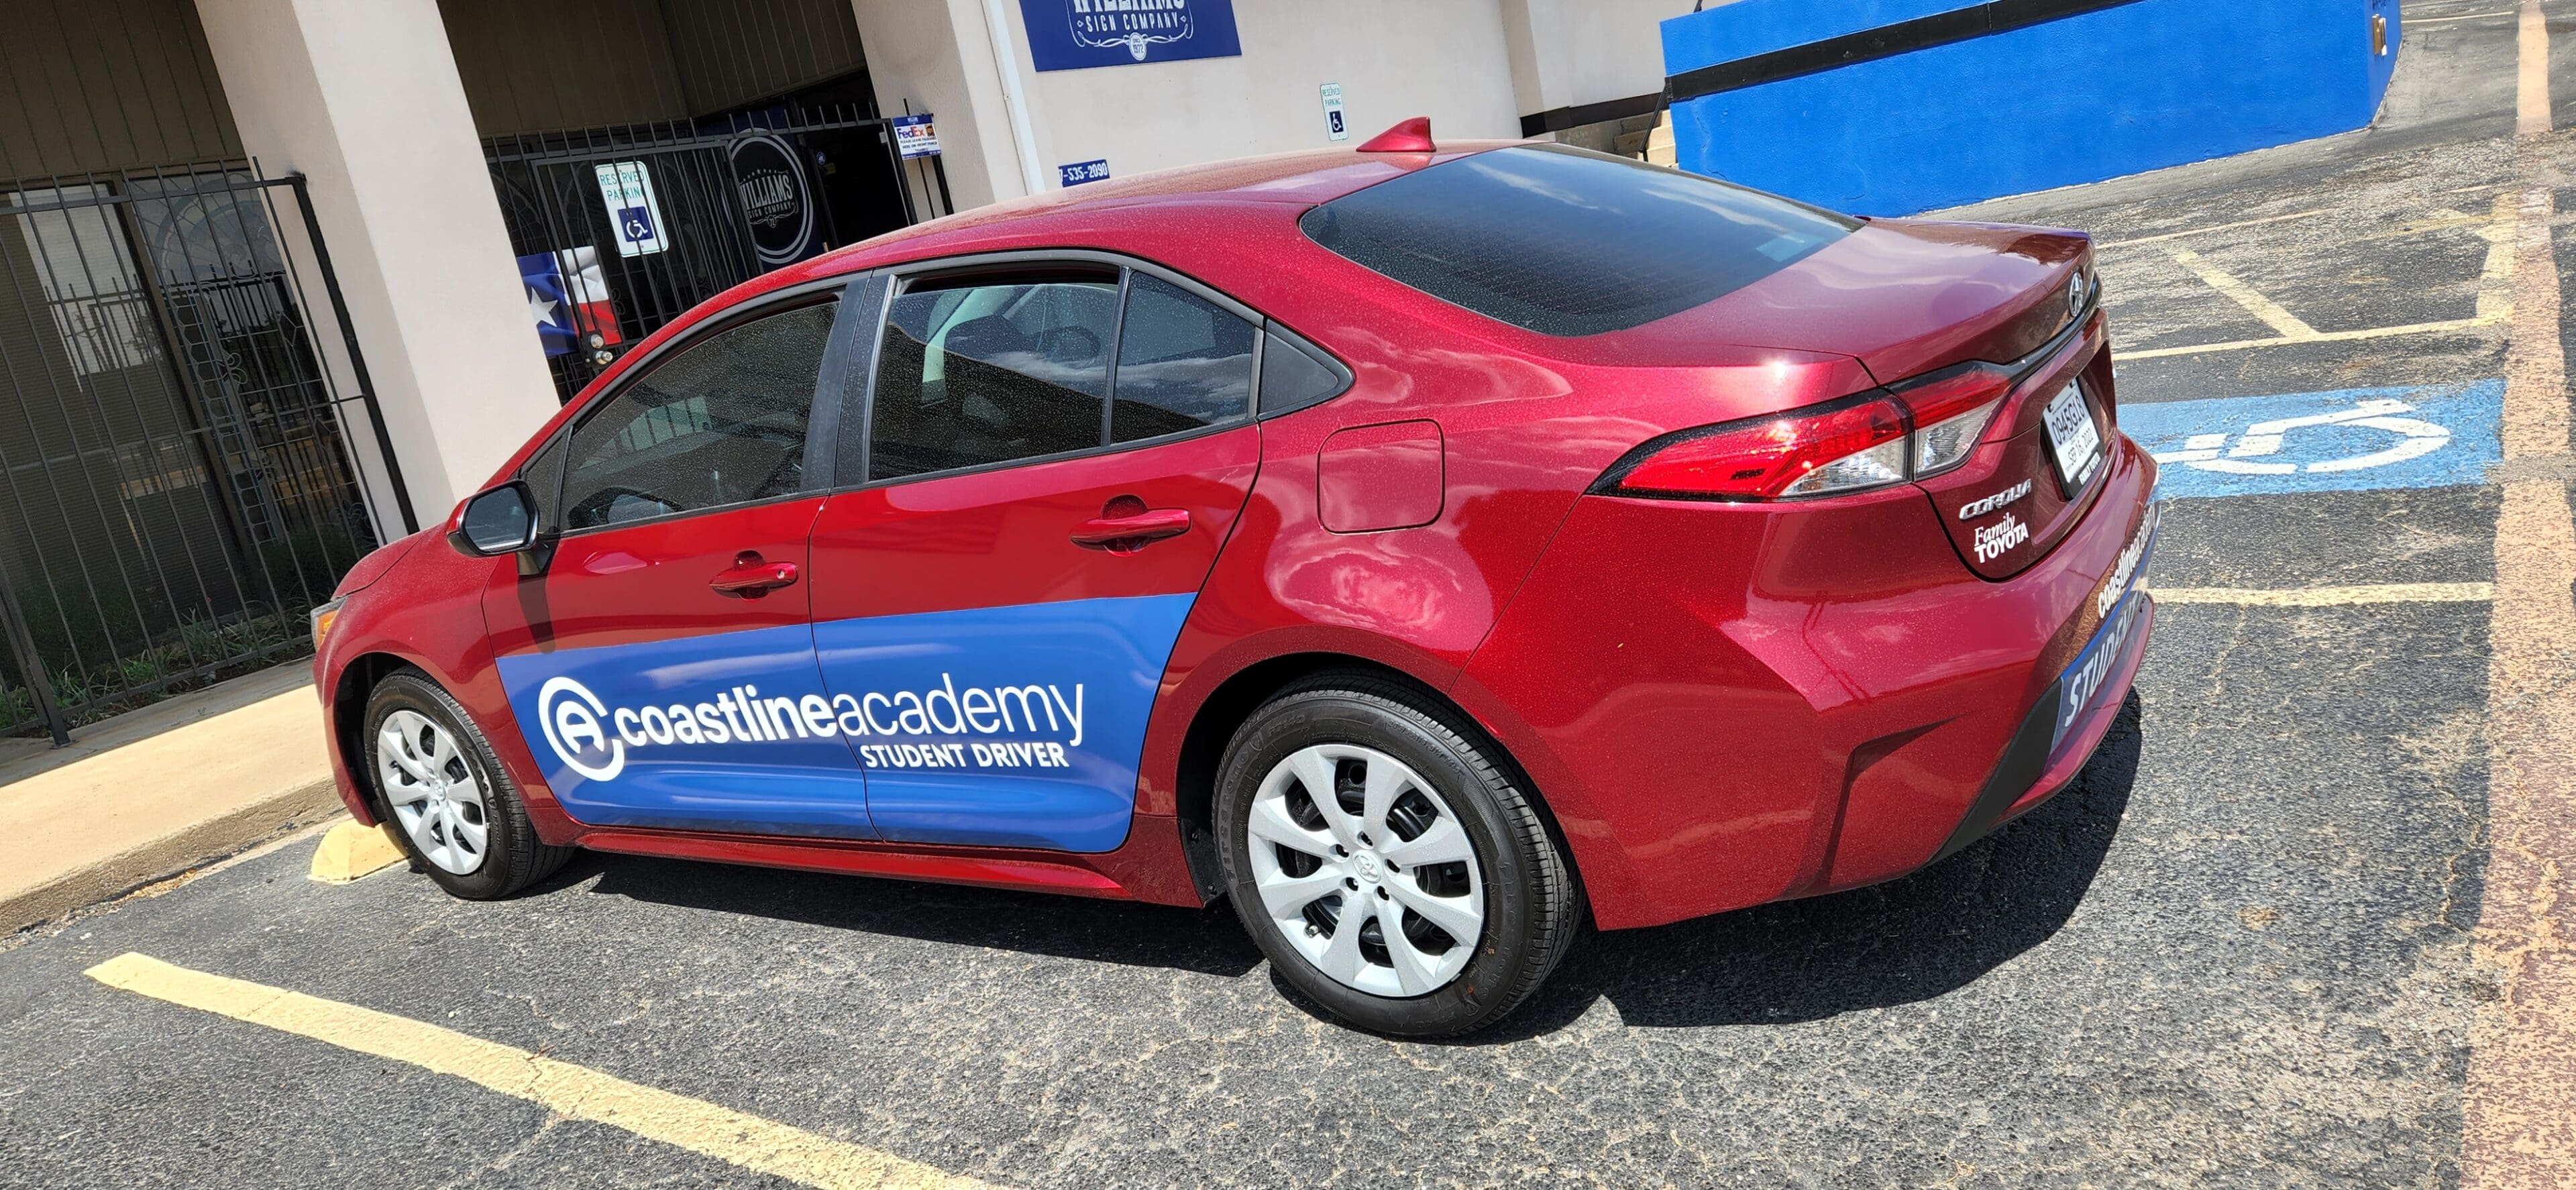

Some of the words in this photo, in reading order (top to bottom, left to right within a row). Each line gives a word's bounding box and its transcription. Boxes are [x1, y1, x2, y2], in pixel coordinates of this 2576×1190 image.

[1085, 15, 1116, 32] SIGN
[1123, 12, 1178, 30] COMPANY
[896, 126, 924, 139] FedEx
[600, 170, 645, 186] RESRVED
[606, 186, 645, 201] PARKIN
[2051, 395, 2085, 445] 0945G18
[1959, 478, 2031, 520] COROLLA
[1974, 512, 2015, 547] Family
[1974, 522, 2029, 563] TOYOTA
[614, 673, 1083, 747] coastlineacademy
[860, 743, 966, 767] STUDENT
[970, 742, 1069, 767] DRIVER
